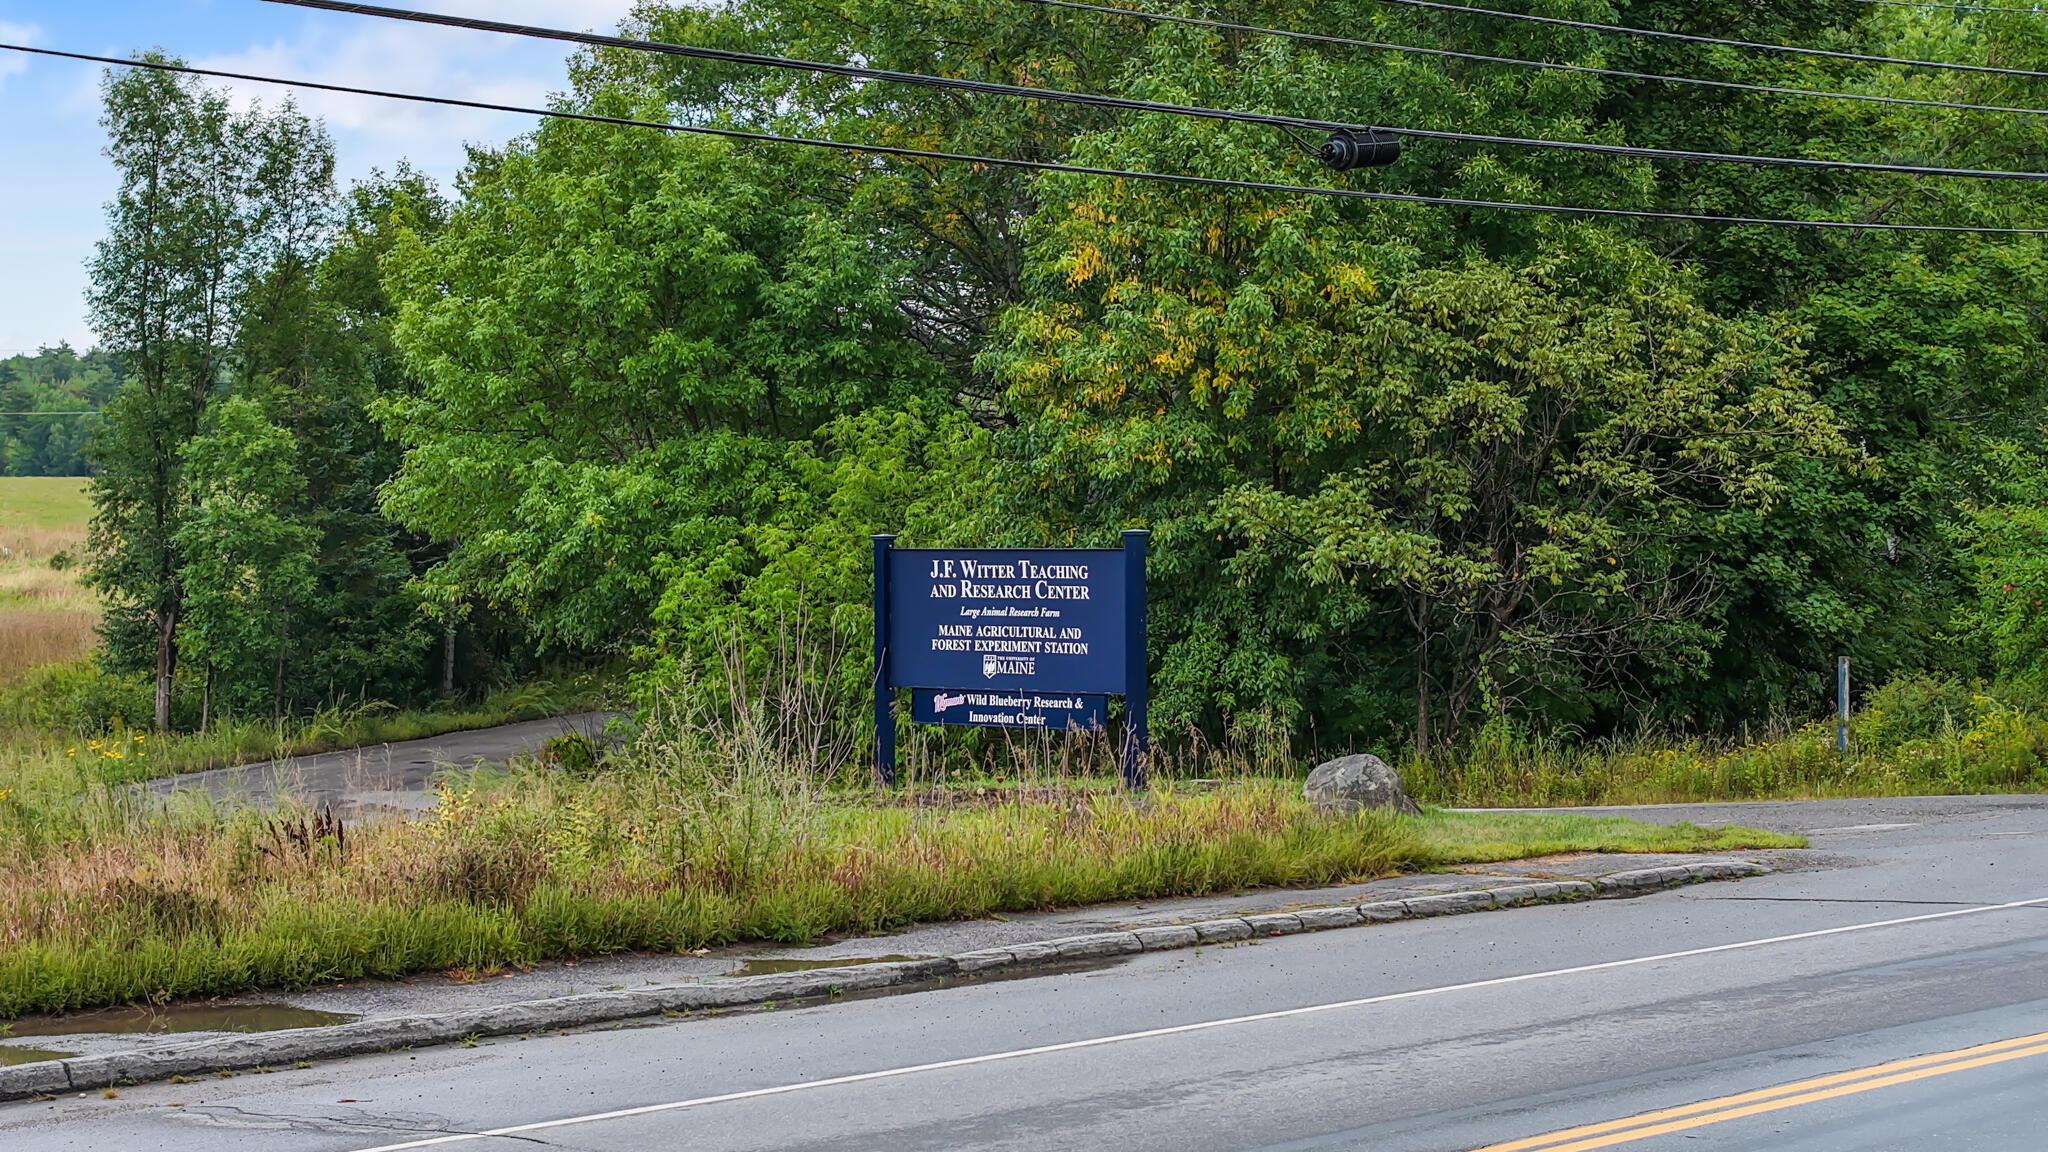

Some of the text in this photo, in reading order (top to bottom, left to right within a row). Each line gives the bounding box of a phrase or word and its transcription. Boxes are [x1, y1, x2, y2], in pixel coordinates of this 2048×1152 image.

[930, 559, 1089, 579] J.F. WITTER TEACHING
[930, 580, 1090, 600] AND RESEARCH CENTER
[960, 606, 1060, 619] Large Animal Research Farm
[939, 625, 1081, 639] MAINE AGRICULTURAL AND
[931, 639, 1088, 655] FOREST EXPERIMENT STATION
[997, 662, 1035, 675] MAINE
[967, 694, 988, 706] Wild
[990, 695, 1032, 710] Blueberry
[1034, 697, 1073, 709] Research
[1075, 698, 1083, 709] &
[969, 712, 1046, 725] Innovation Center
